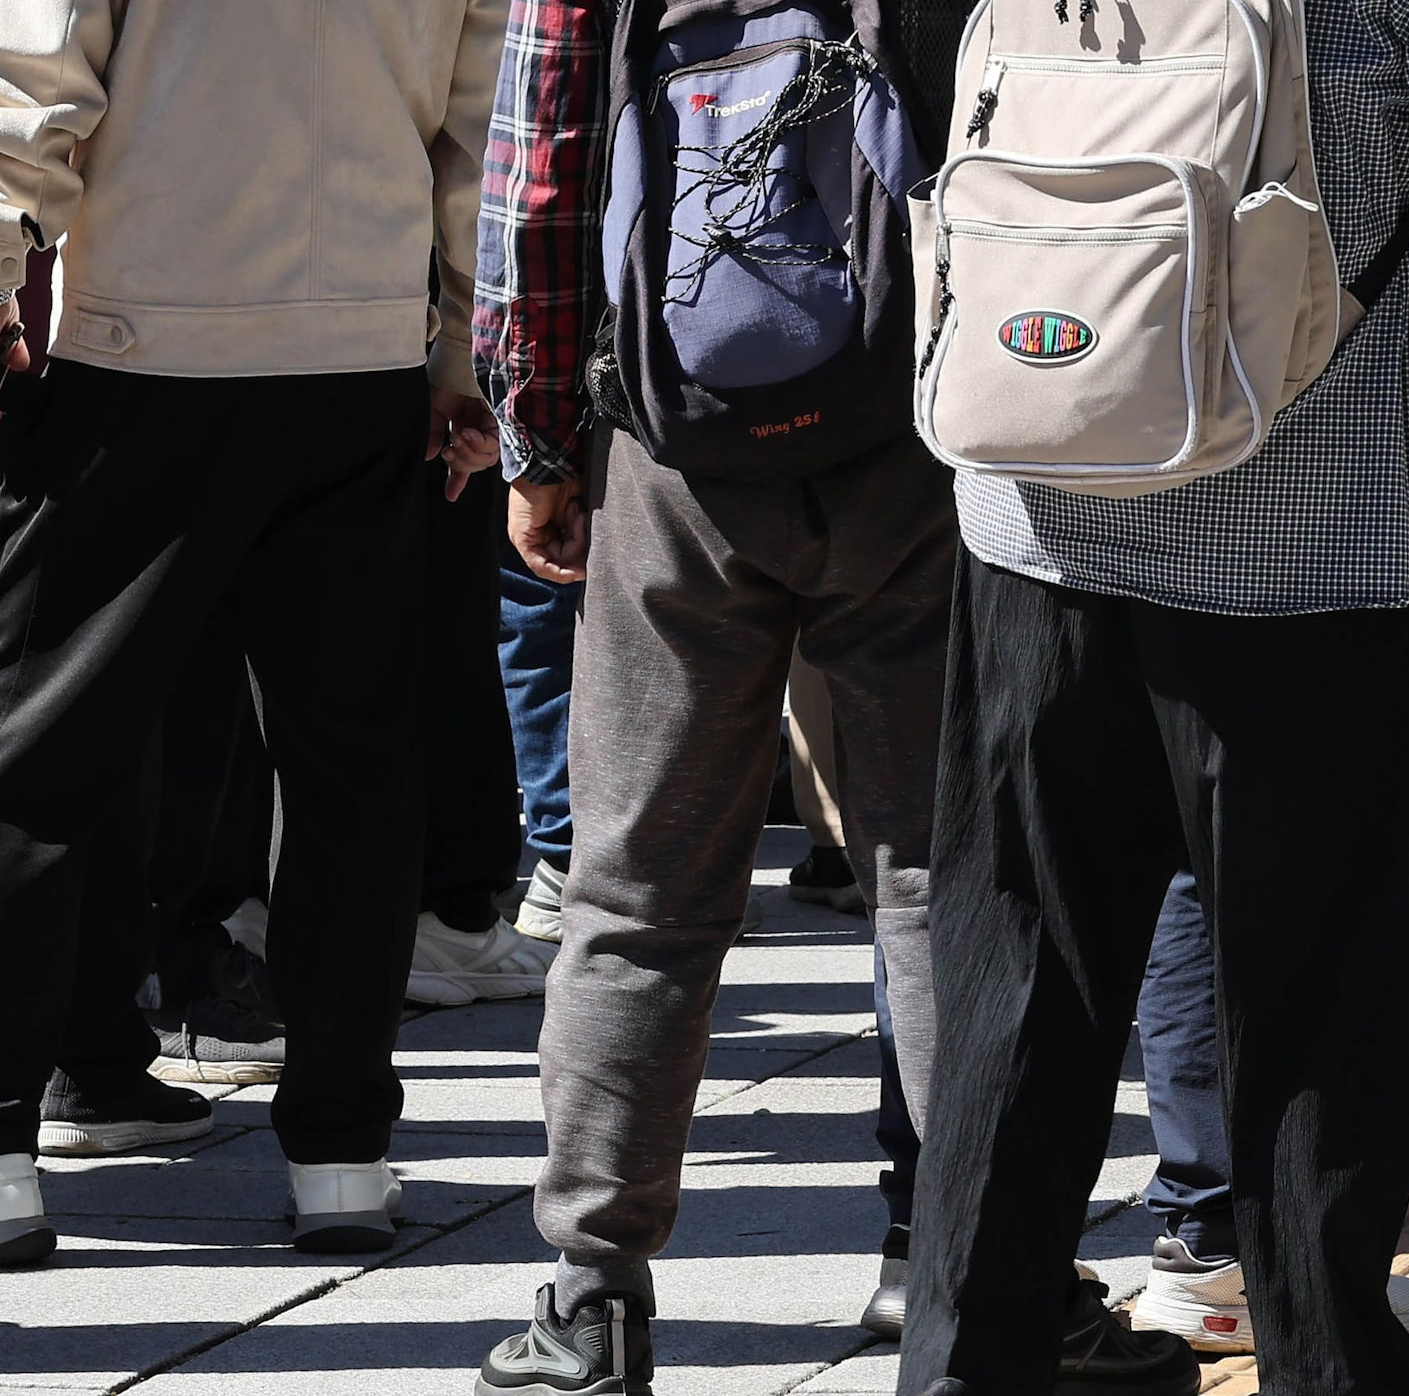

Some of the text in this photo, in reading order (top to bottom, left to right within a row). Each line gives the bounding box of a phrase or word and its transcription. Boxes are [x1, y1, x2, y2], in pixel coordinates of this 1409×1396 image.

[1002, 315, 1087, 354] WIGGLE WIGGLE
[750, 422, 790, 439] Wing
